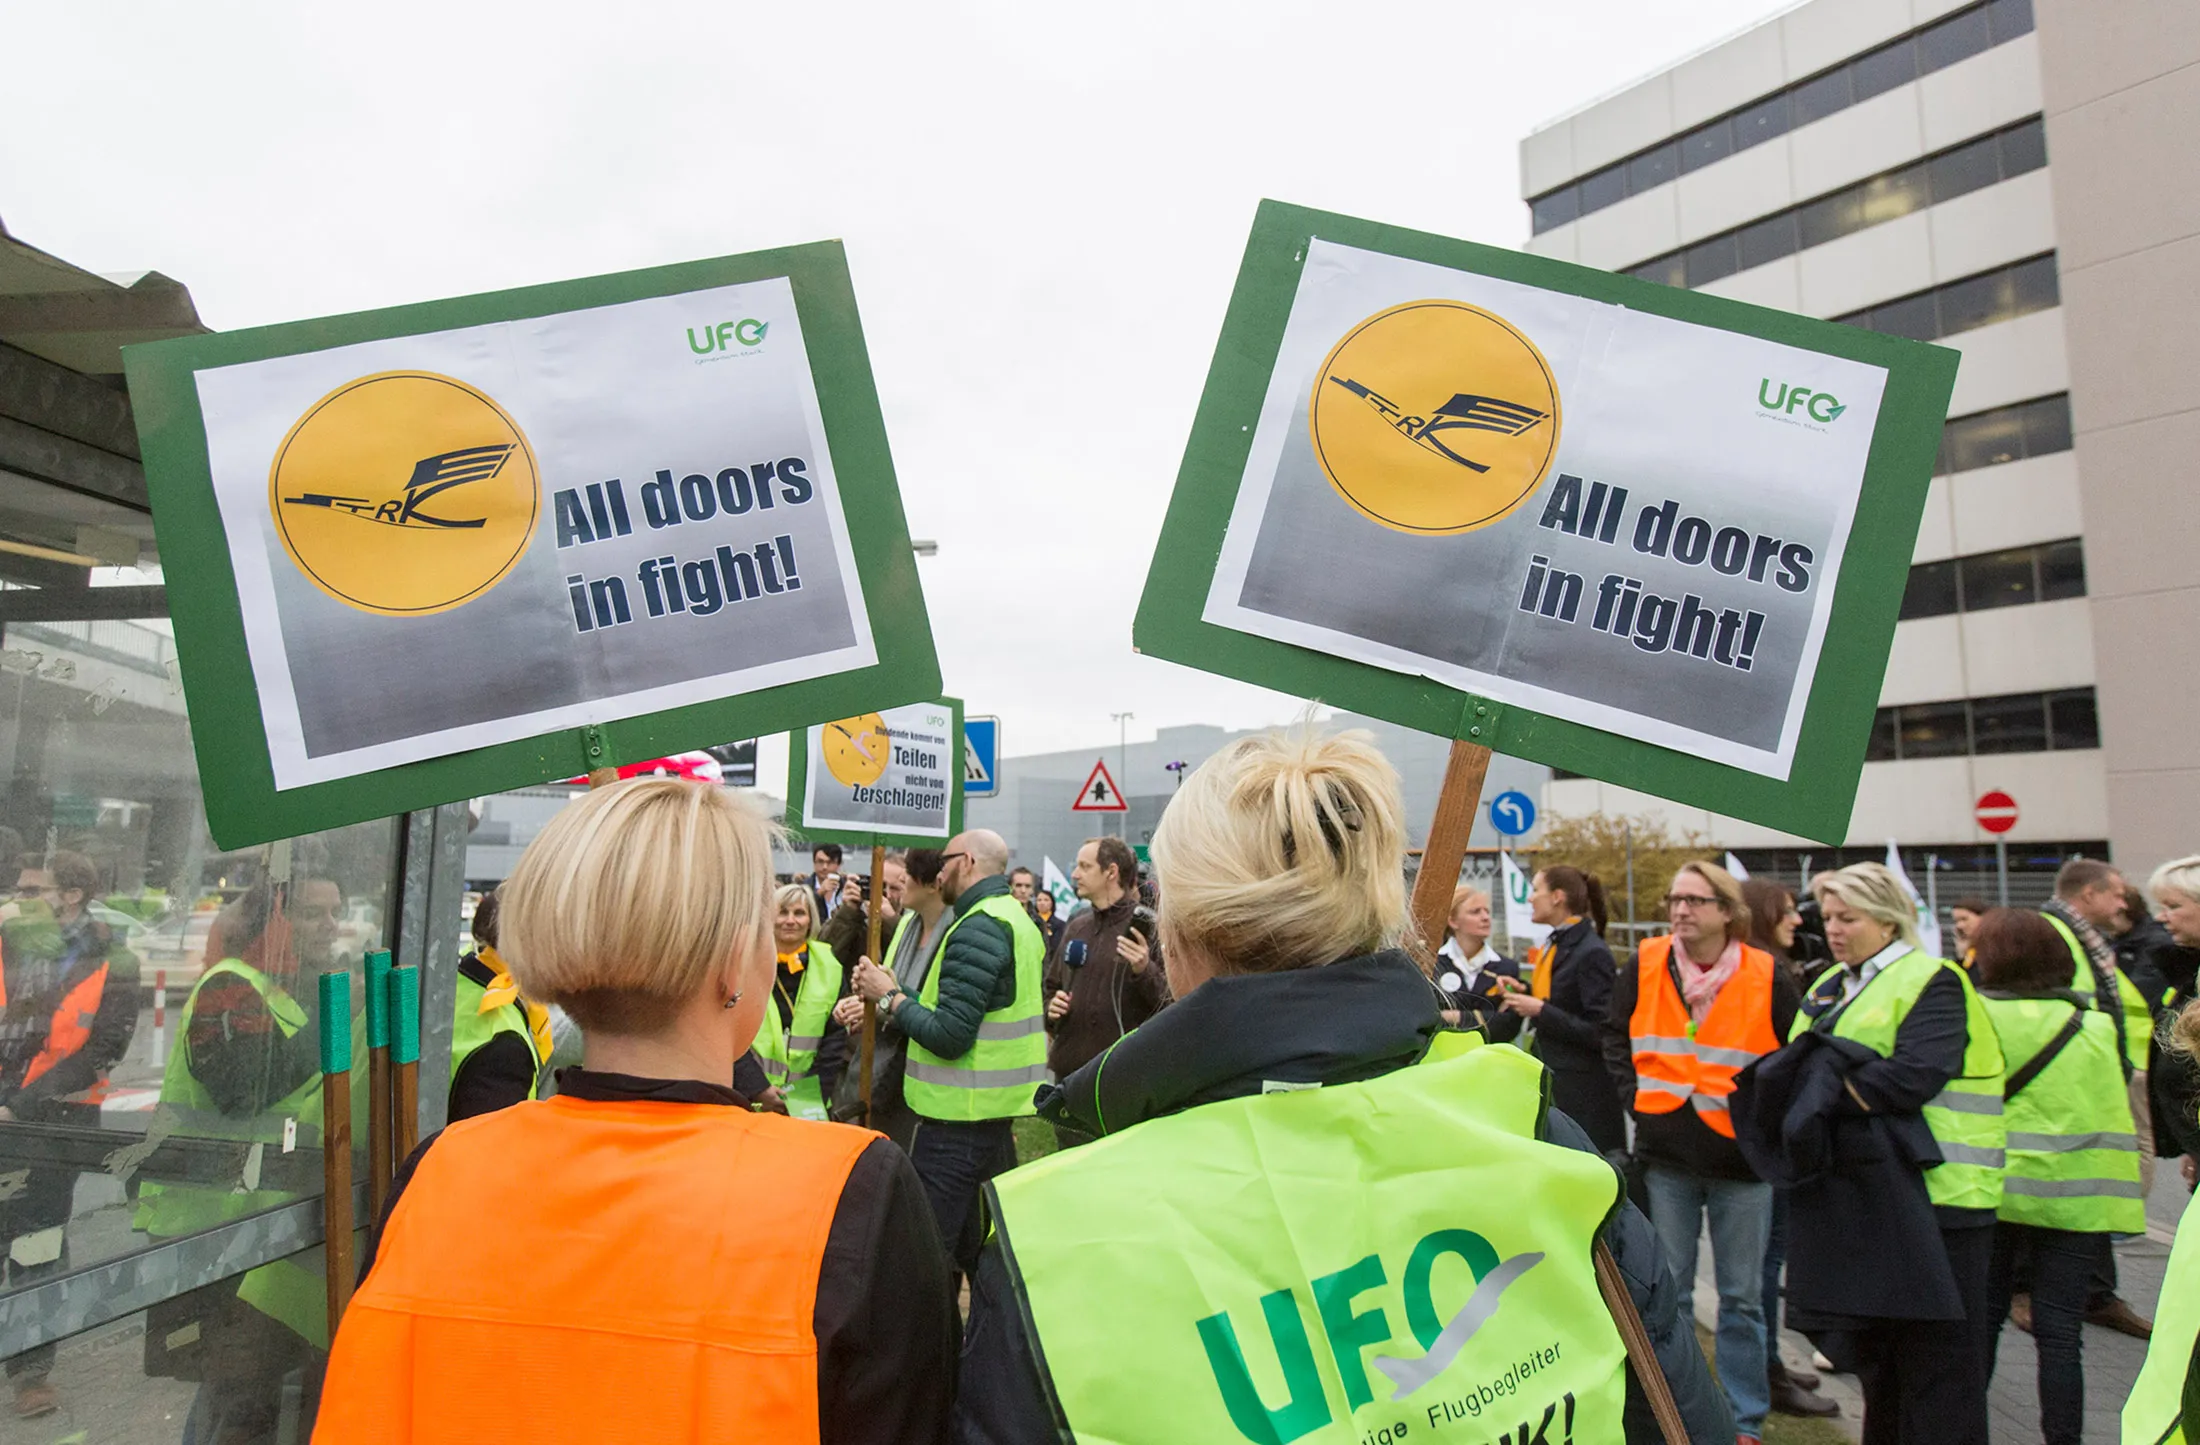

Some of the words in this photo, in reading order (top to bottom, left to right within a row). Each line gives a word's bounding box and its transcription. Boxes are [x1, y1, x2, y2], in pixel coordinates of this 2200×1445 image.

[686, 318, 768, 355] UFO
[1758, 377, 1847, 423] UFO
[553, 478, 633, 549] All
[640, 457, 813, 530] doors
[1537, 472, 1629, 546] All
[1631, 498, 1815, 593] doors
[566, 573, 634, 634] in
[637, 533, 803, 617] fight!
[1517, 554, 1585, 624] in
[1590, 572, 1767, 672] fight!
[926, 715, 944, 727] UFO
[894, 746, 936, 769] Teilen
[905, 774, 928, 788] nicht
[929, 778, 944, 789] von
[852, 783, 944, 810] Zerschlagen!
[1195, 1228, 1502, 1445] UFO
[1427, 1342, 1562, 1428] Flugbegleiter
